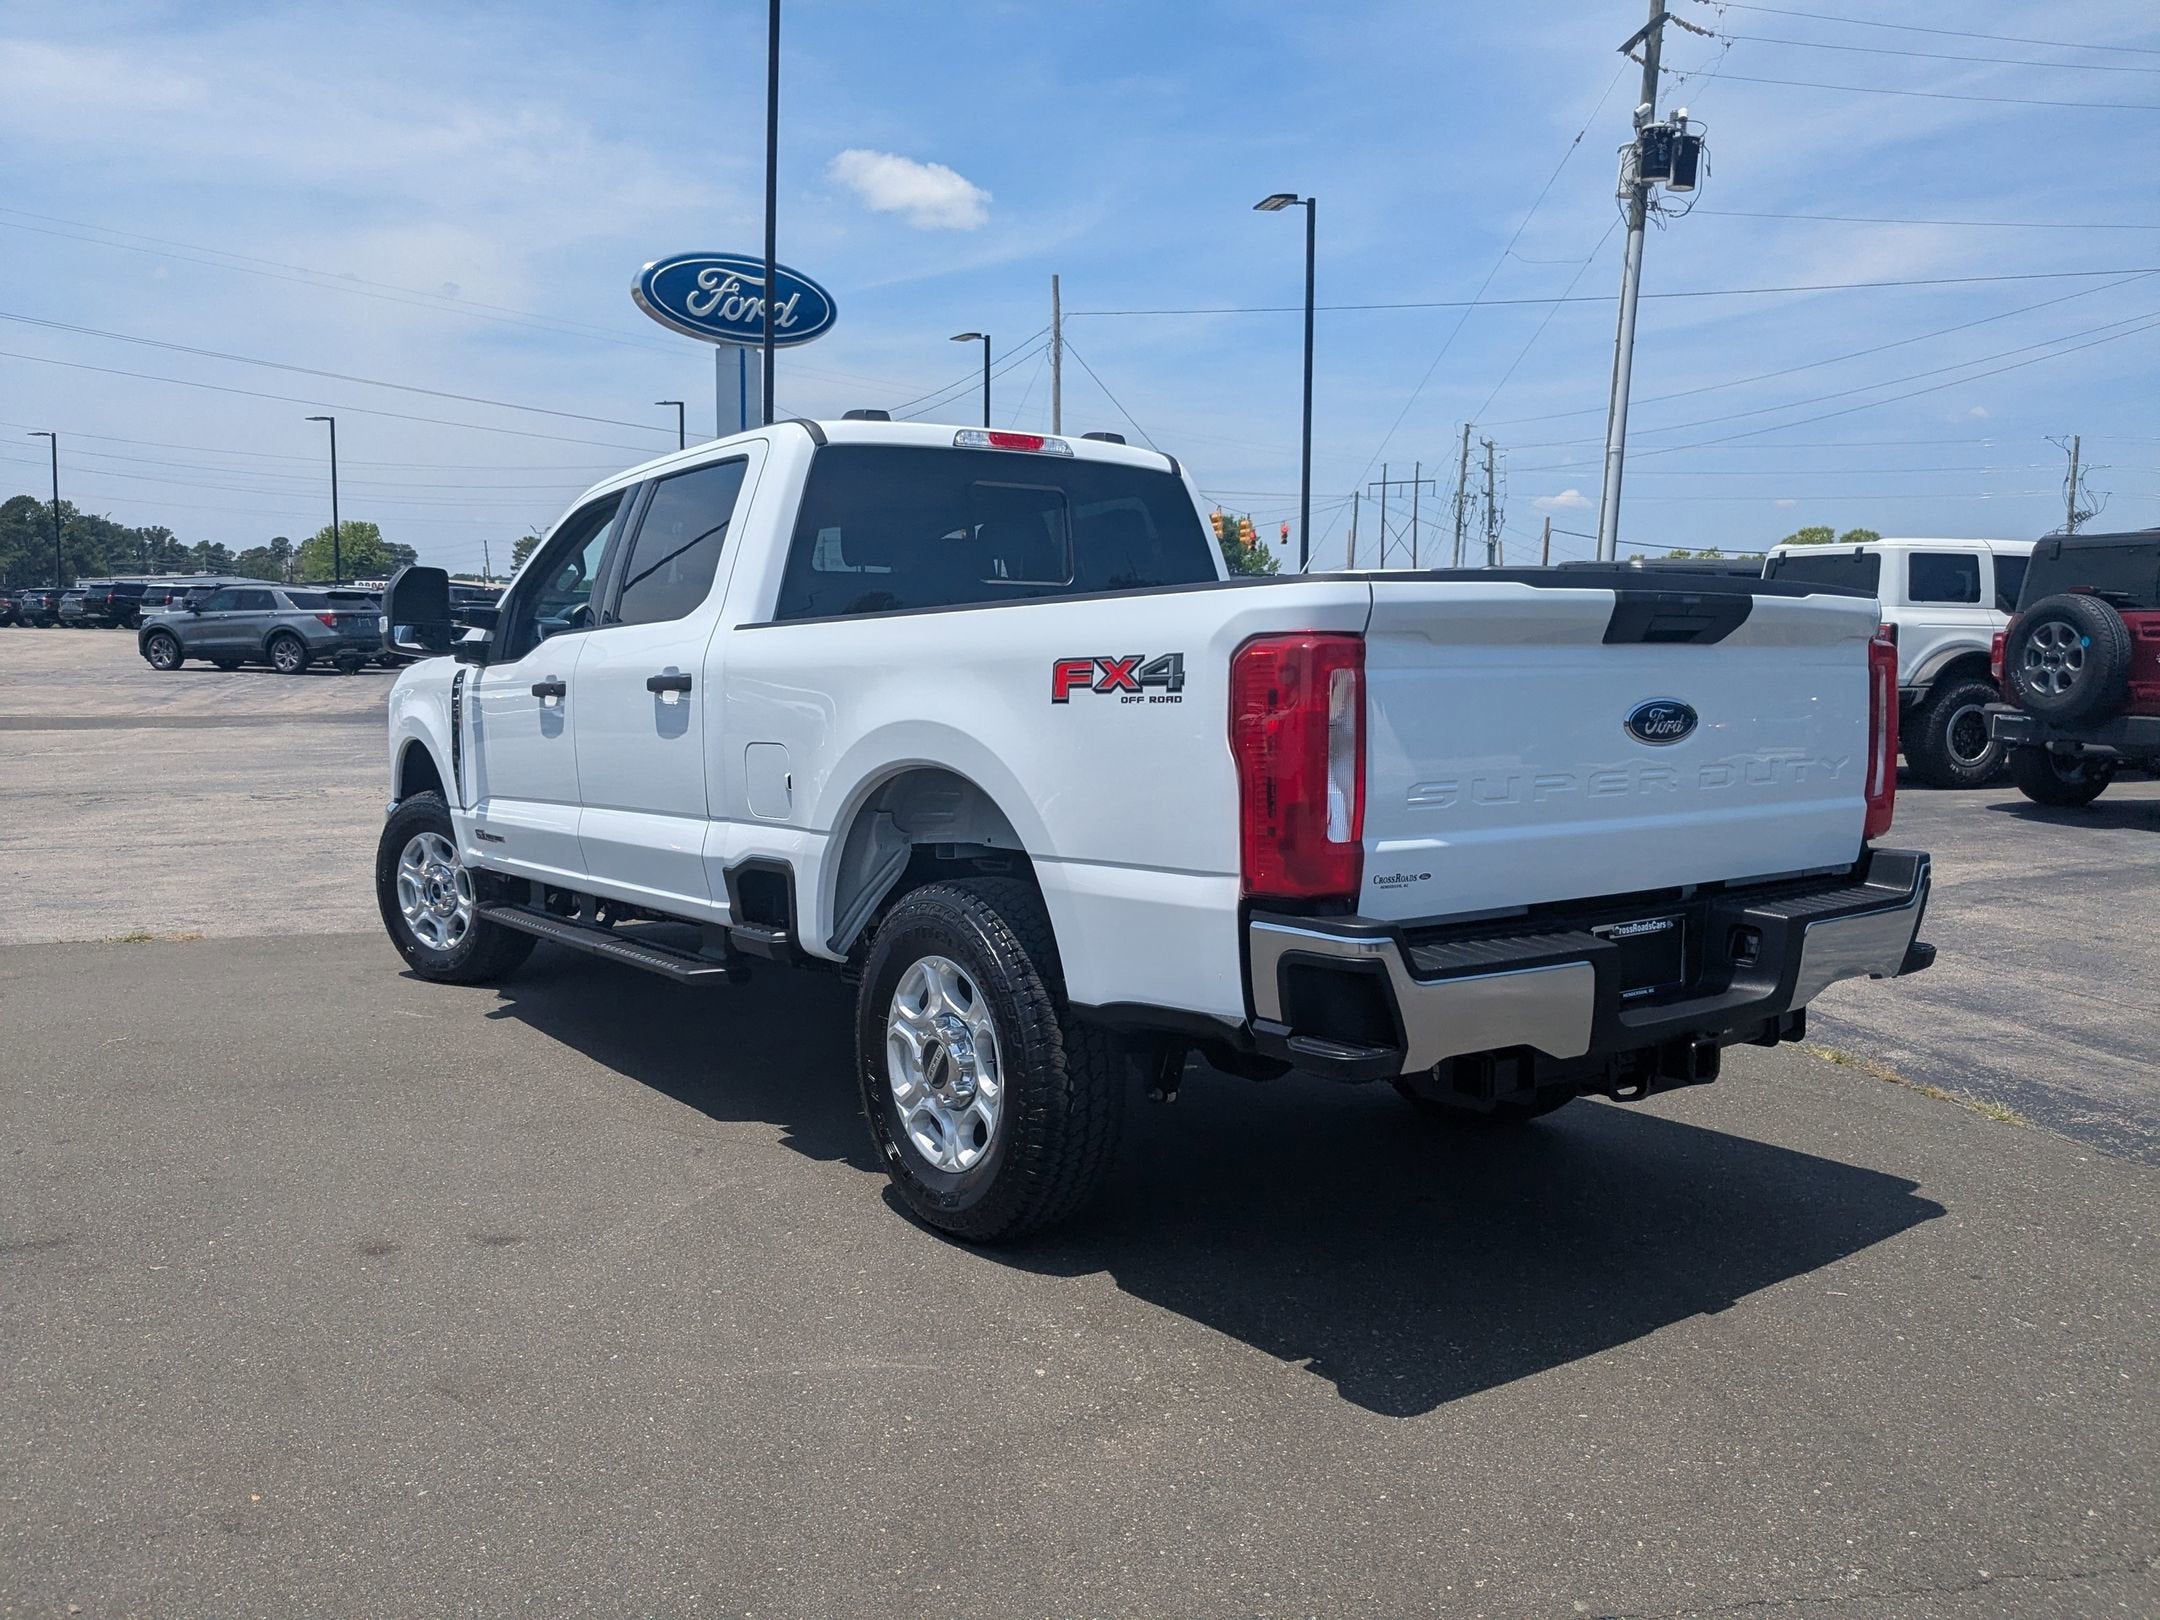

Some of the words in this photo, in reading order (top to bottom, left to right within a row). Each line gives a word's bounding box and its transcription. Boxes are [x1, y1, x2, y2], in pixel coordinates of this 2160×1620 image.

[686, 267, 801, 328] Ford
[1052, 652, 1186, 704] FX4
[1120, 695, 1145, 704] OFF
[1149, 695, 1183, 704] ROAD
[1644, 707, 1685, 735] Ford
[1407, 766, 1679, 811] SUPER
[1700, 754, 1850, 790] DUTY
